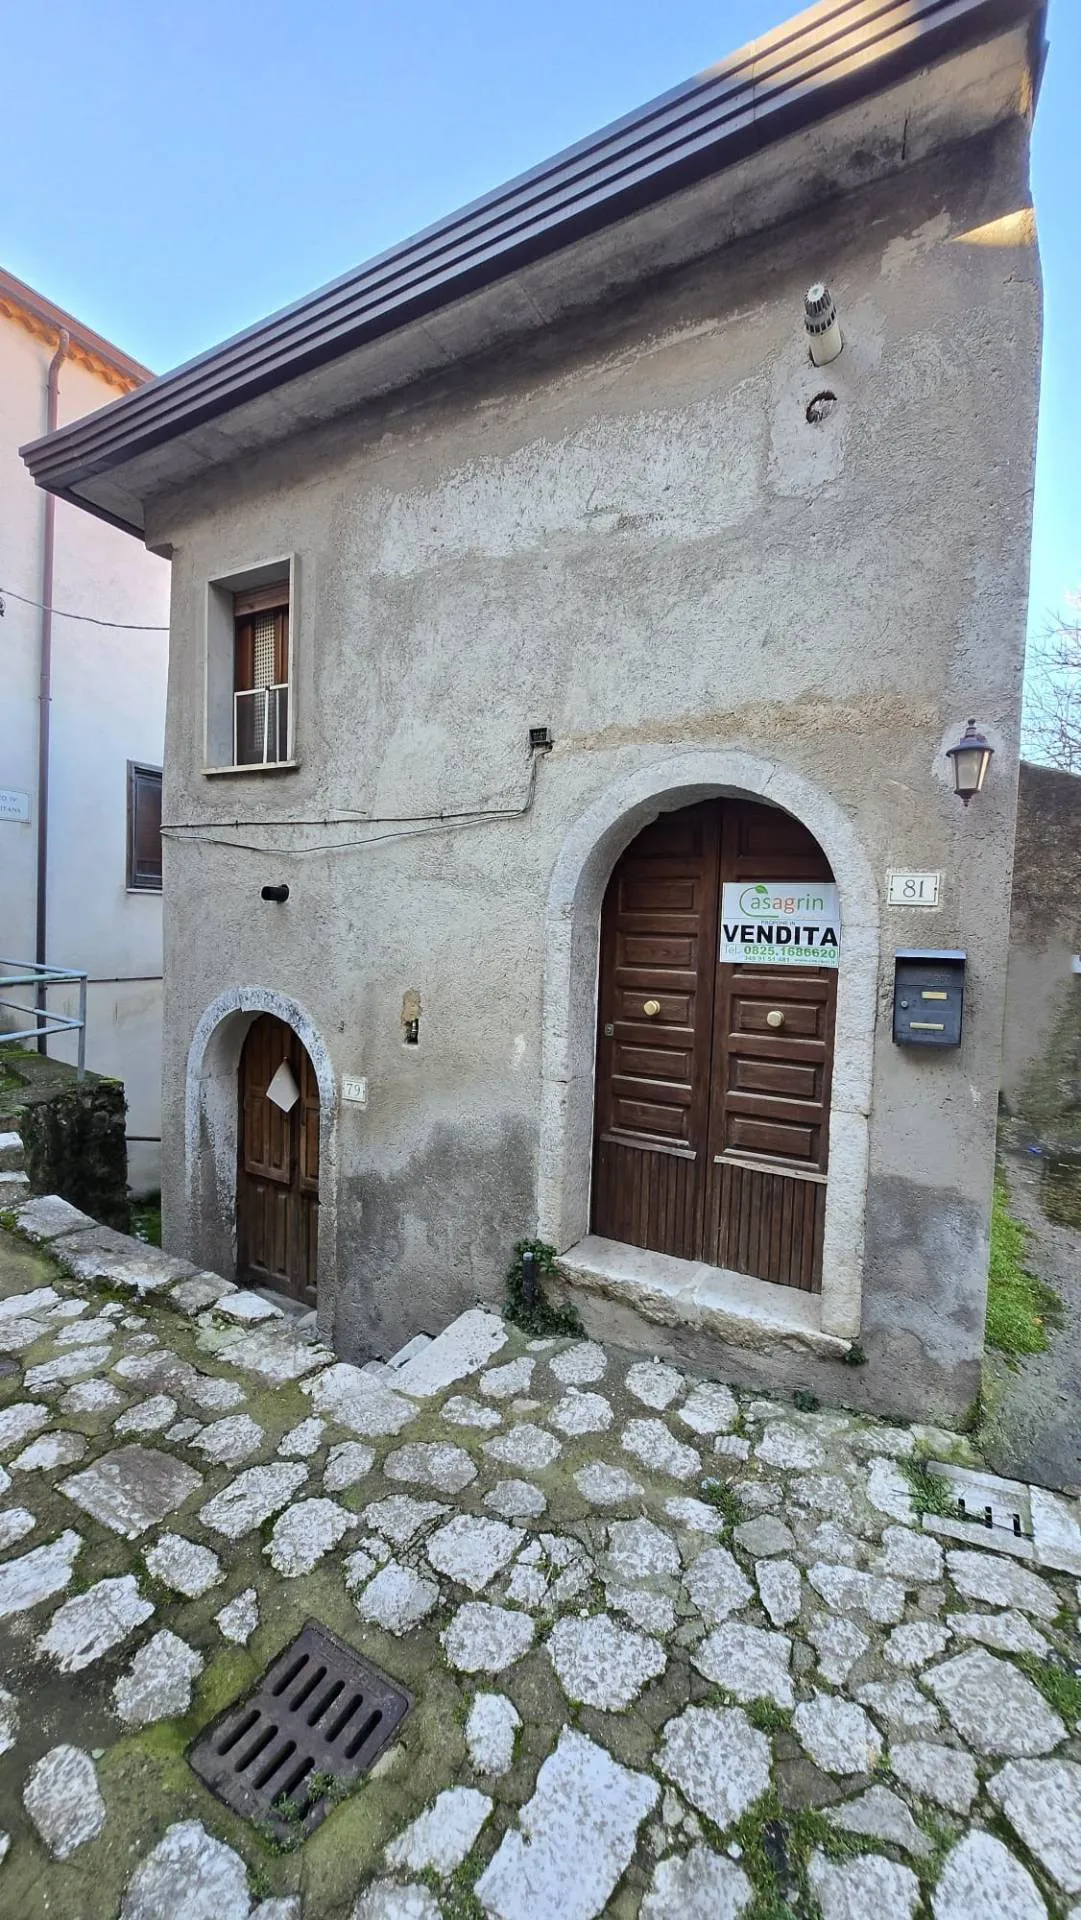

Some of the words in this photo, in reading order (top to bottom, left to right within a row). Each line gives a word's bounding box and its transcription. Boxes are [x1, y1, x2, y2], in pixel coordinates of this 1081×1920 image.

[903, 879, 924, 898] 81
[740, 885, 824, 918] Casagrin
[723, 923, 838, 946] VENDITA
[744, 945, 836, 959] 0825.1686620
[346, 1083, 361, 1097] 79
